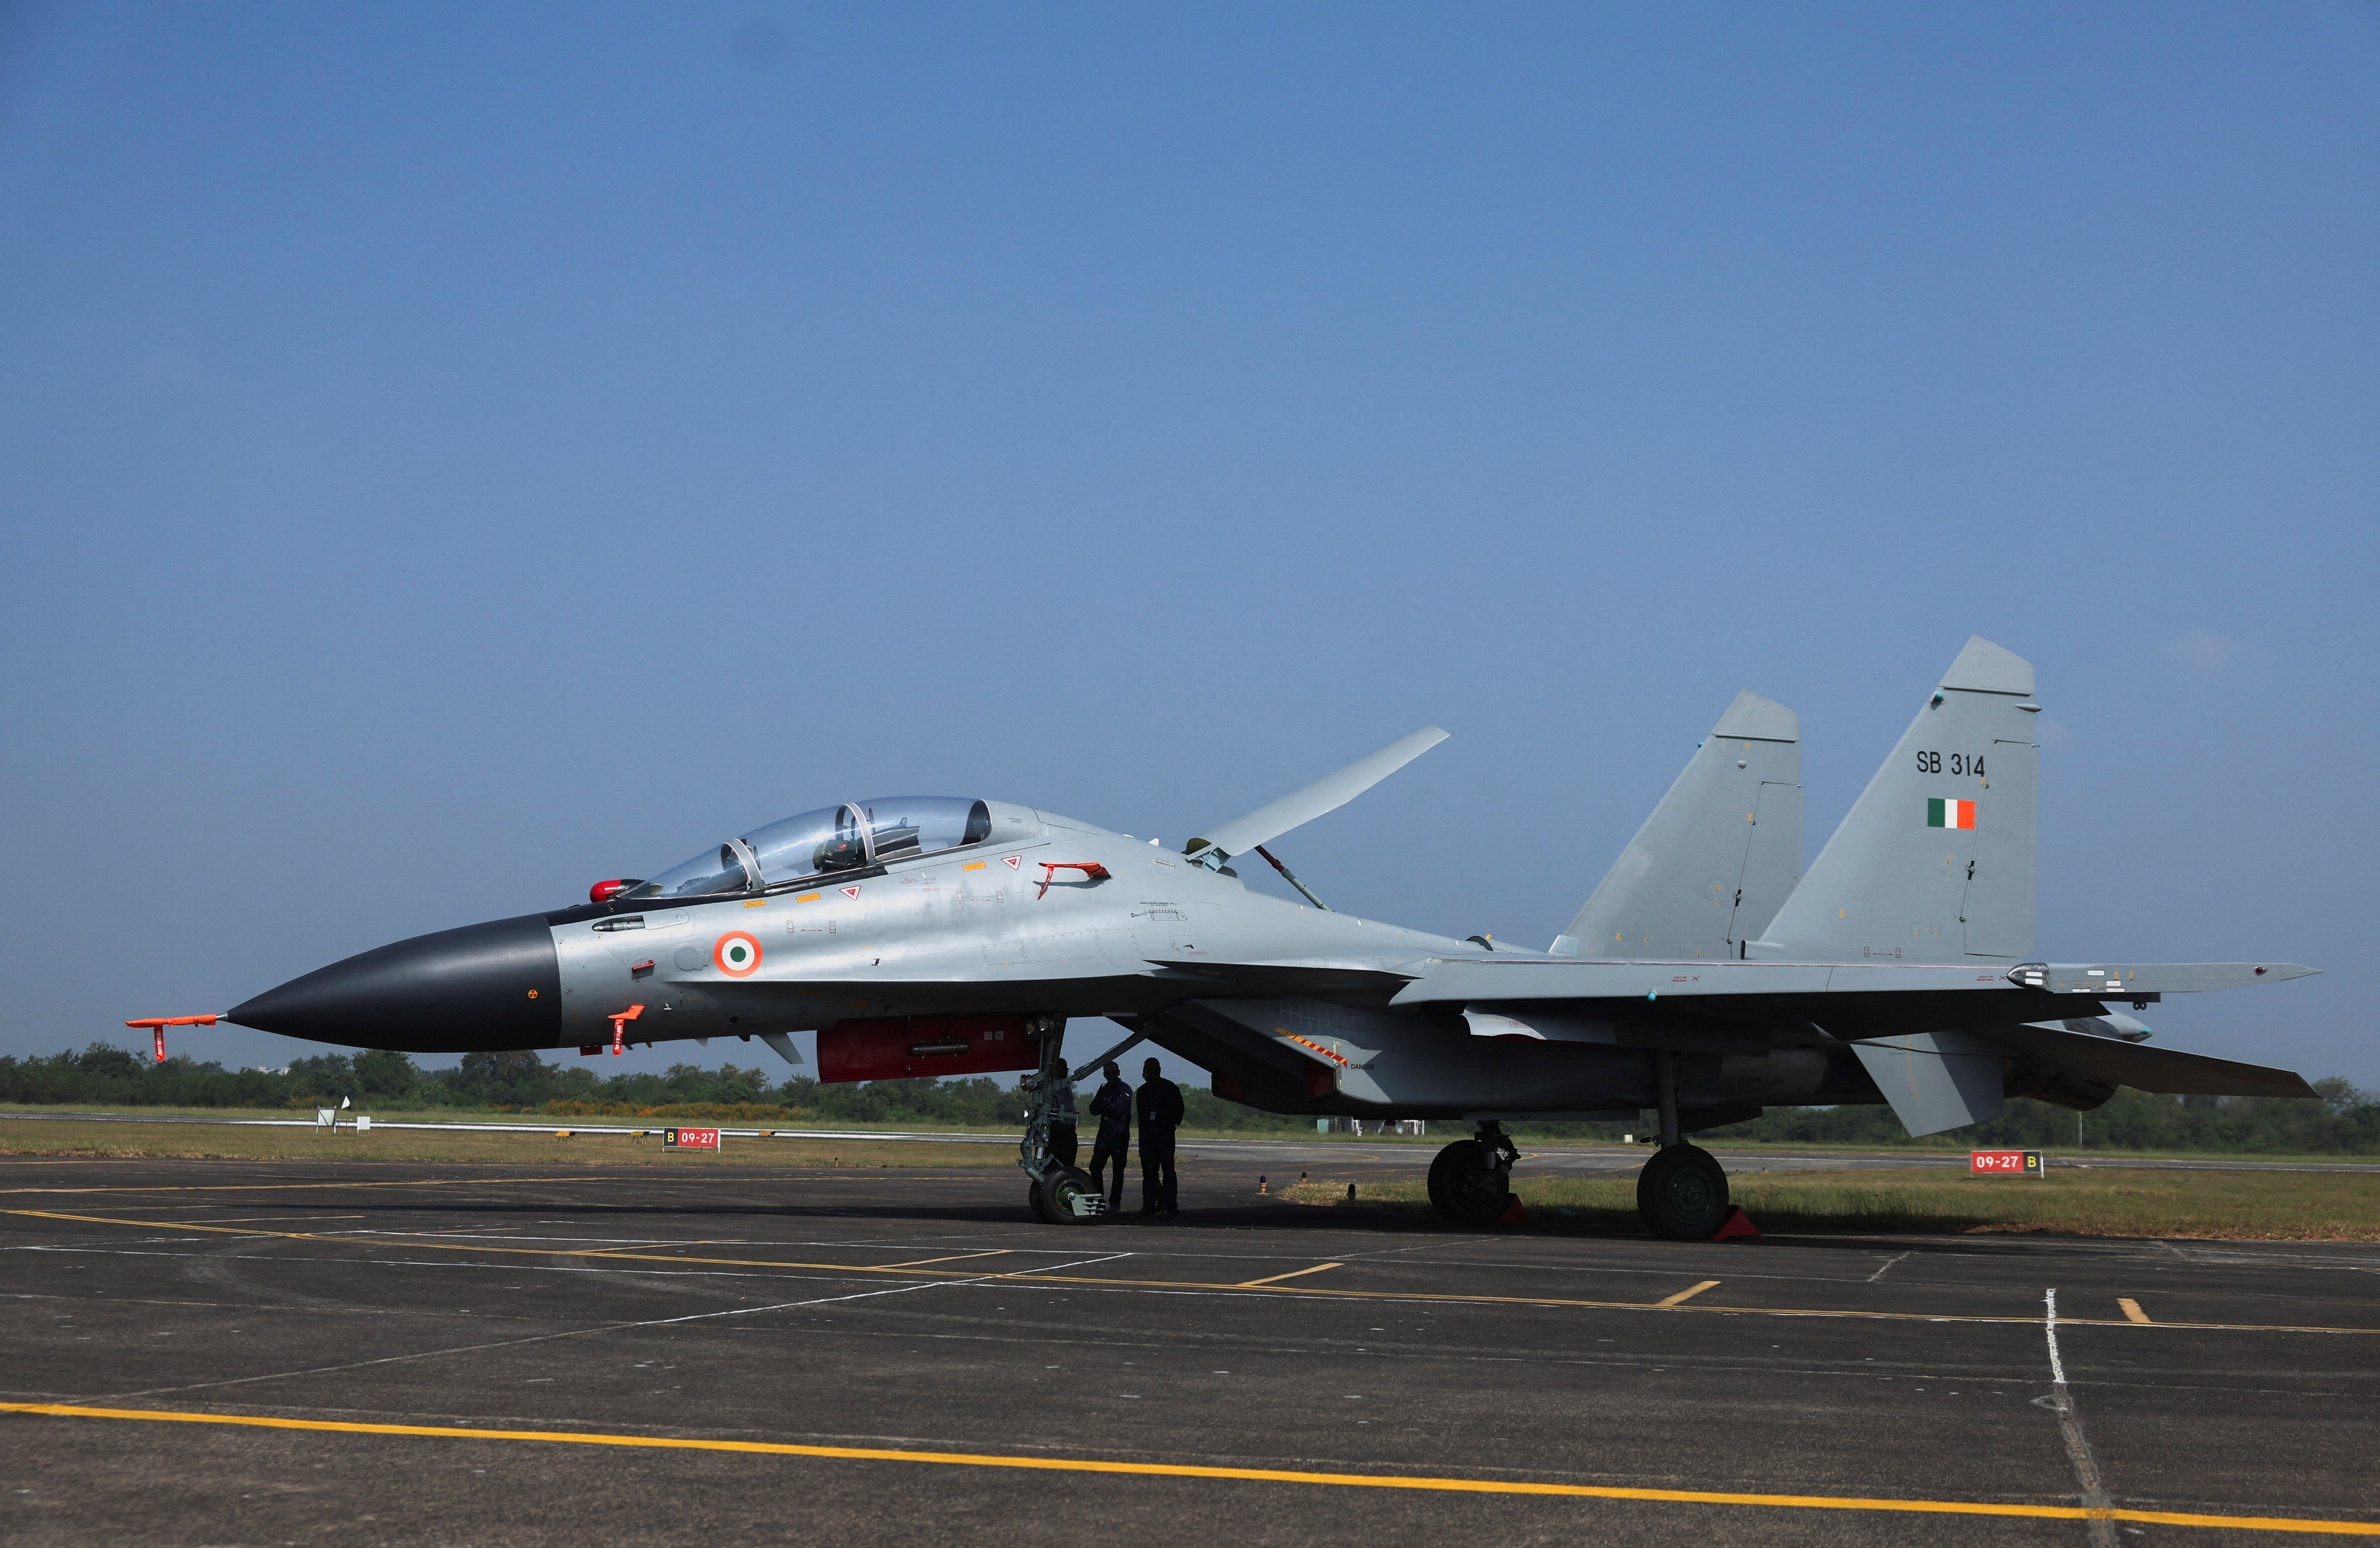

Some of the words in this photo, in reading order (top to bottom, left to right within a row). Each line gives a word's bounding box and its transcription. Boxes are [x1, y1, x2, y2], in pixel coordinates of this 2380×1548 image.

[1917, 751, 1942, 774] SB
[1951, 753, 1985, 777] 314
[667, 1132, 674, 1142] B
[682, 1132, 714, 1143] 09-27
[1976, 1156, 2019, 1168] 09-27
[2027, 1156, 2037, 1167] B
